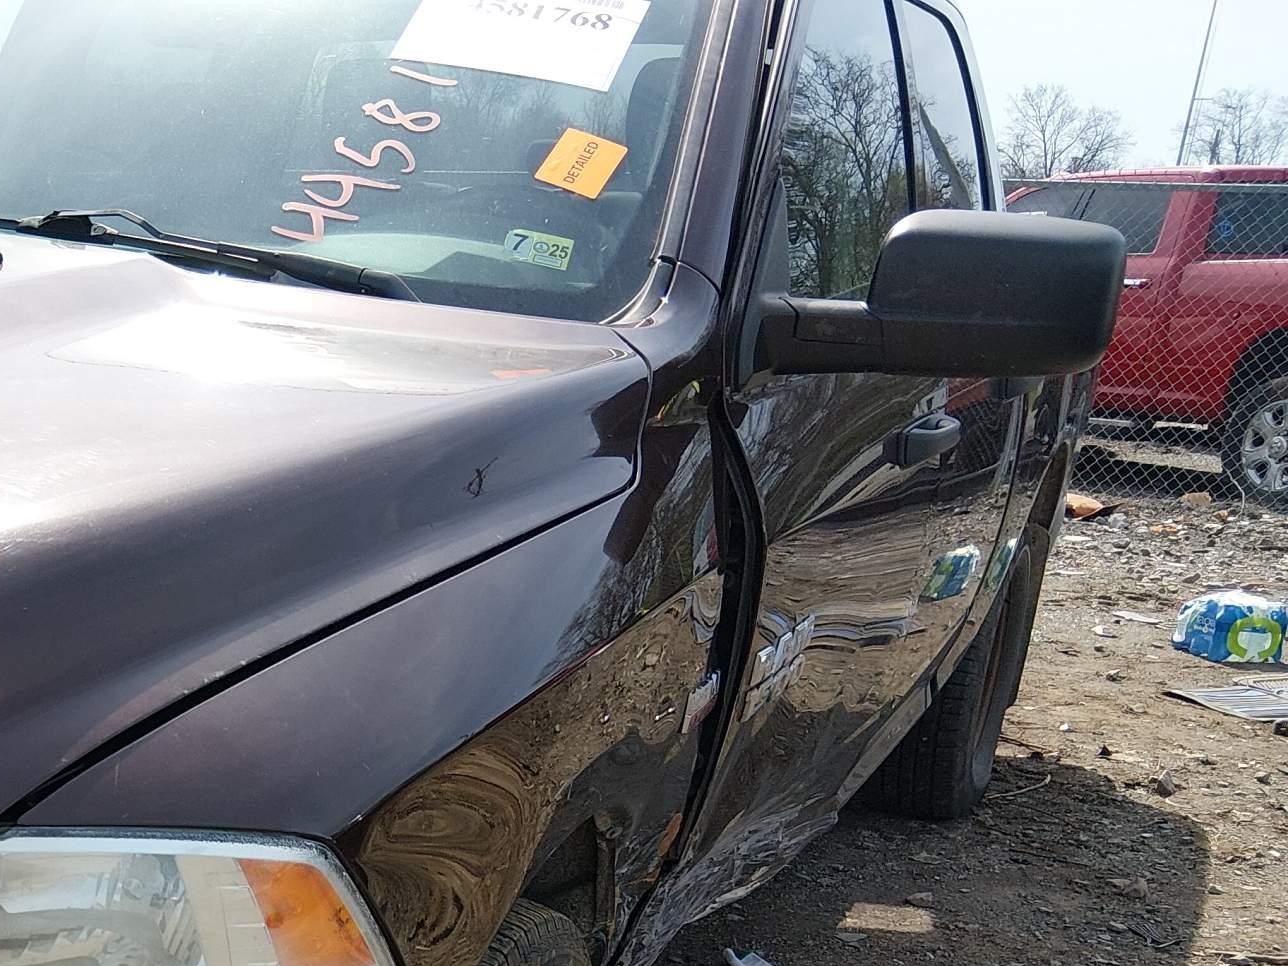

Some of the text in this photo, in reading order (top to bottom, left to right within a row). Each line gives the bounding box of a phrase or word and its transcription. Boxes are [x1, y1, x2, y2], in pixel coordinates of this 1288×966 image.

[270, 65, 458, 242] 44581
[562, 141, 599, 184] DETAILED
[512, 233, 570, 259] 7 25
